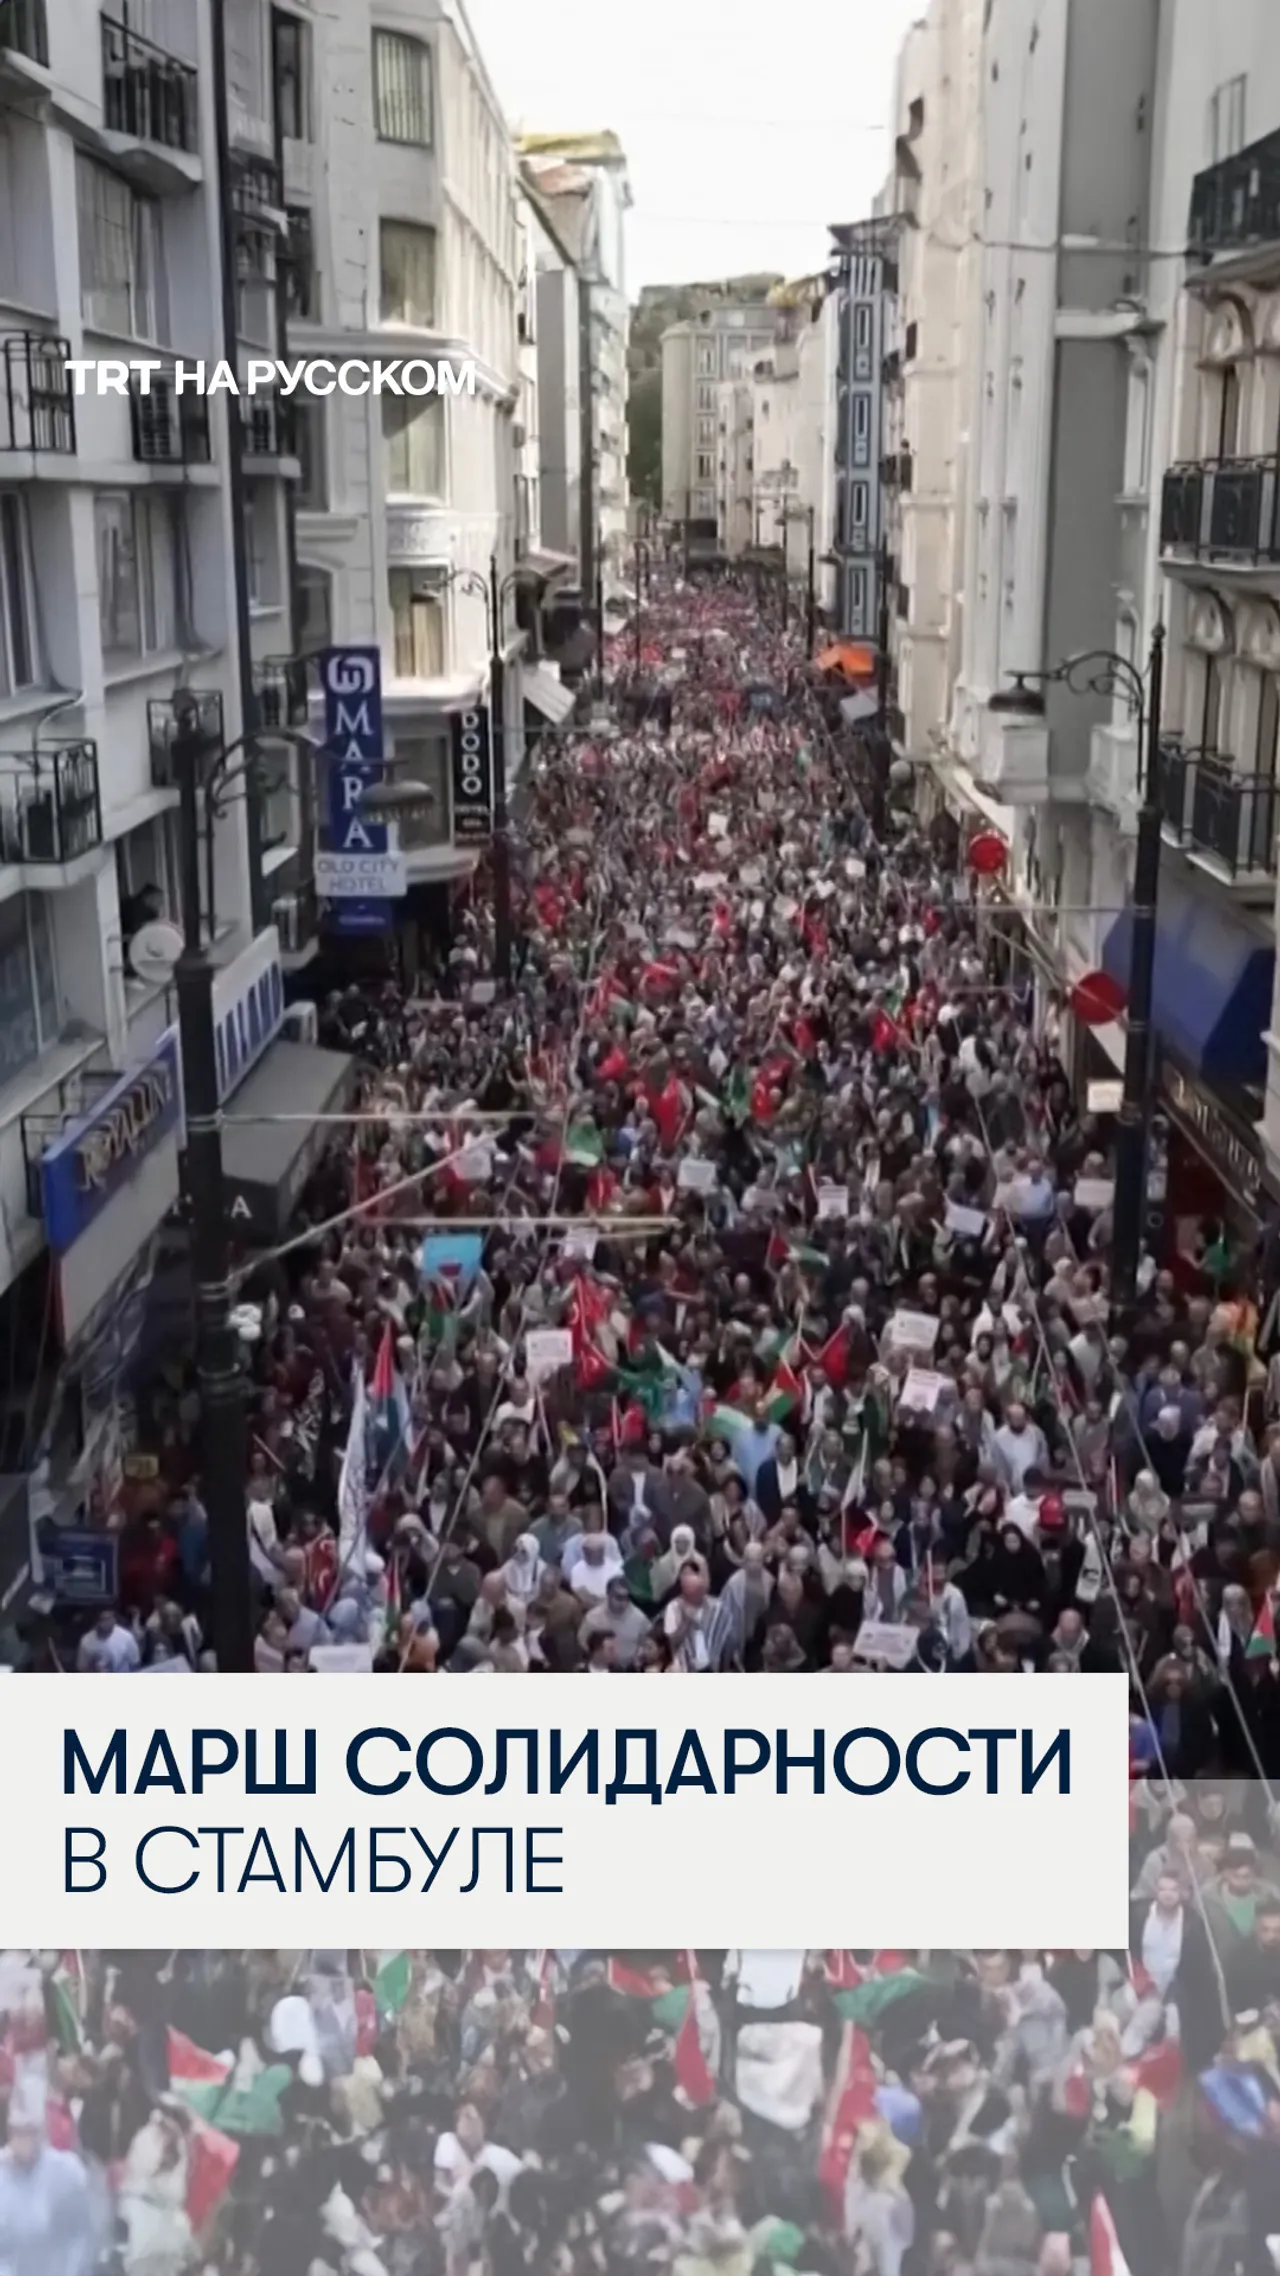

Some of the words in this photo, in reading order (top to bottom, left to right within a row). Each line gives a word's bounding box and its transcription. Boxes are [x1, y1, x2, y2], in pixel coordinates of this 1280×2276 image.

[461, 711, 482, 794] DODO
[317, 859, 354, 873] OLD
[358, 858, 398, 873] CITY
[329, 876, 386, 890] HOTEL
